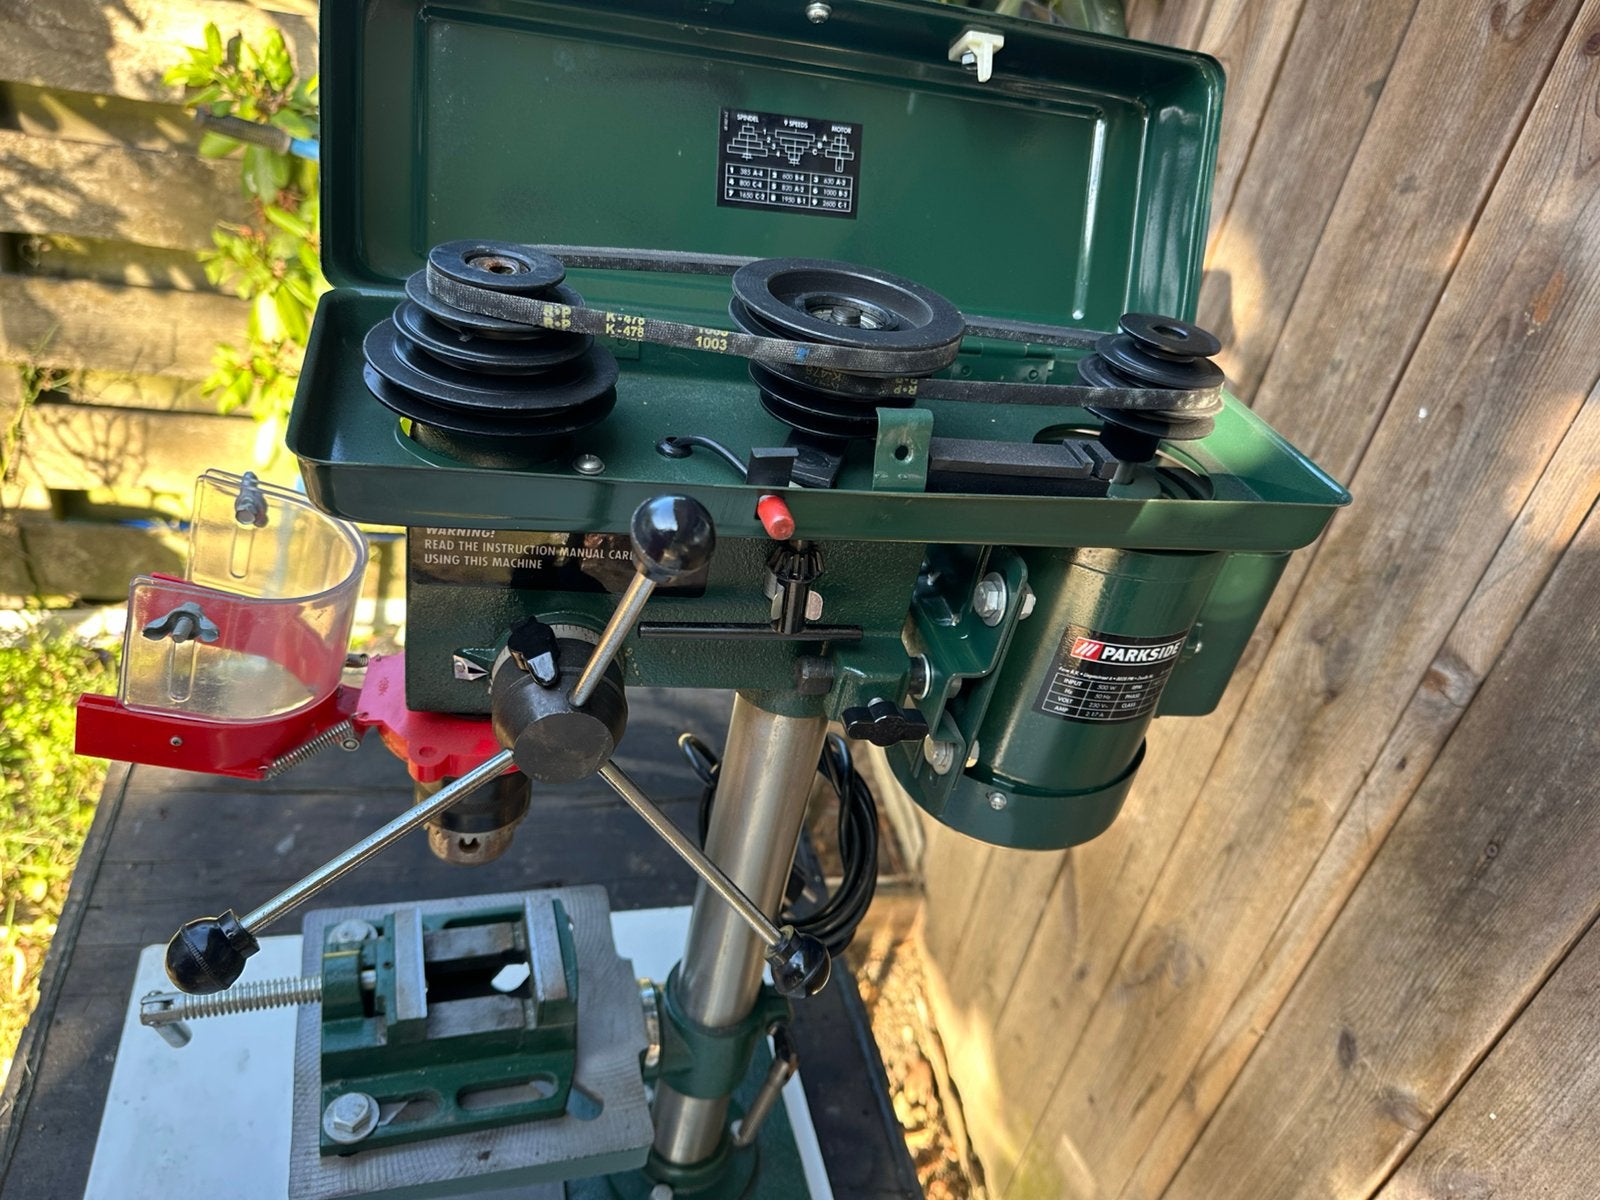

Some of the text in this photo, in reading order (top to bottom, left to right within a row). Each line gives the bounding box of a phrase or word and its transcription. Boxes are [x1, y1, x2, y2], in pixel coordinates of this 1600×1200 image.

[831, 125, 852, 134] MOTOR
[822, 134, 828, 142] A
[816, 141, 823, 149] B
[812, 148, 818, 156] C
[729, 166, 734, 174] 1
[752, 169, 763, 177] A-4
[772, 171, 777, 179] 2
[782, 172, 793, 180] 600
[794, 173, 804, 182] B-4
[813, 175, 819, 183] 3
[728, 177, 735, 185] 4
[771, 182, 777, 190] 5
[812, 187, 819, 195] 6
[728, 189, 734, 197] 7
[605, 322, 645, 338] K-478
[695, 335, 728, 351] 1003
[424, 539, 454, 550] READ
[458, 541, 479, 552] THE
[482, 543, 556, 557] INSTRUCTION
[559, 546, 605, 560] MANUAL
[424, 553, 543, 569] USING THIS MACHINE
[1101, 641, 1181, 662] PARKSIDE
[1063, 678, 1083, 687] INPUT
[1057, 696, 1074, 704] VOLT
